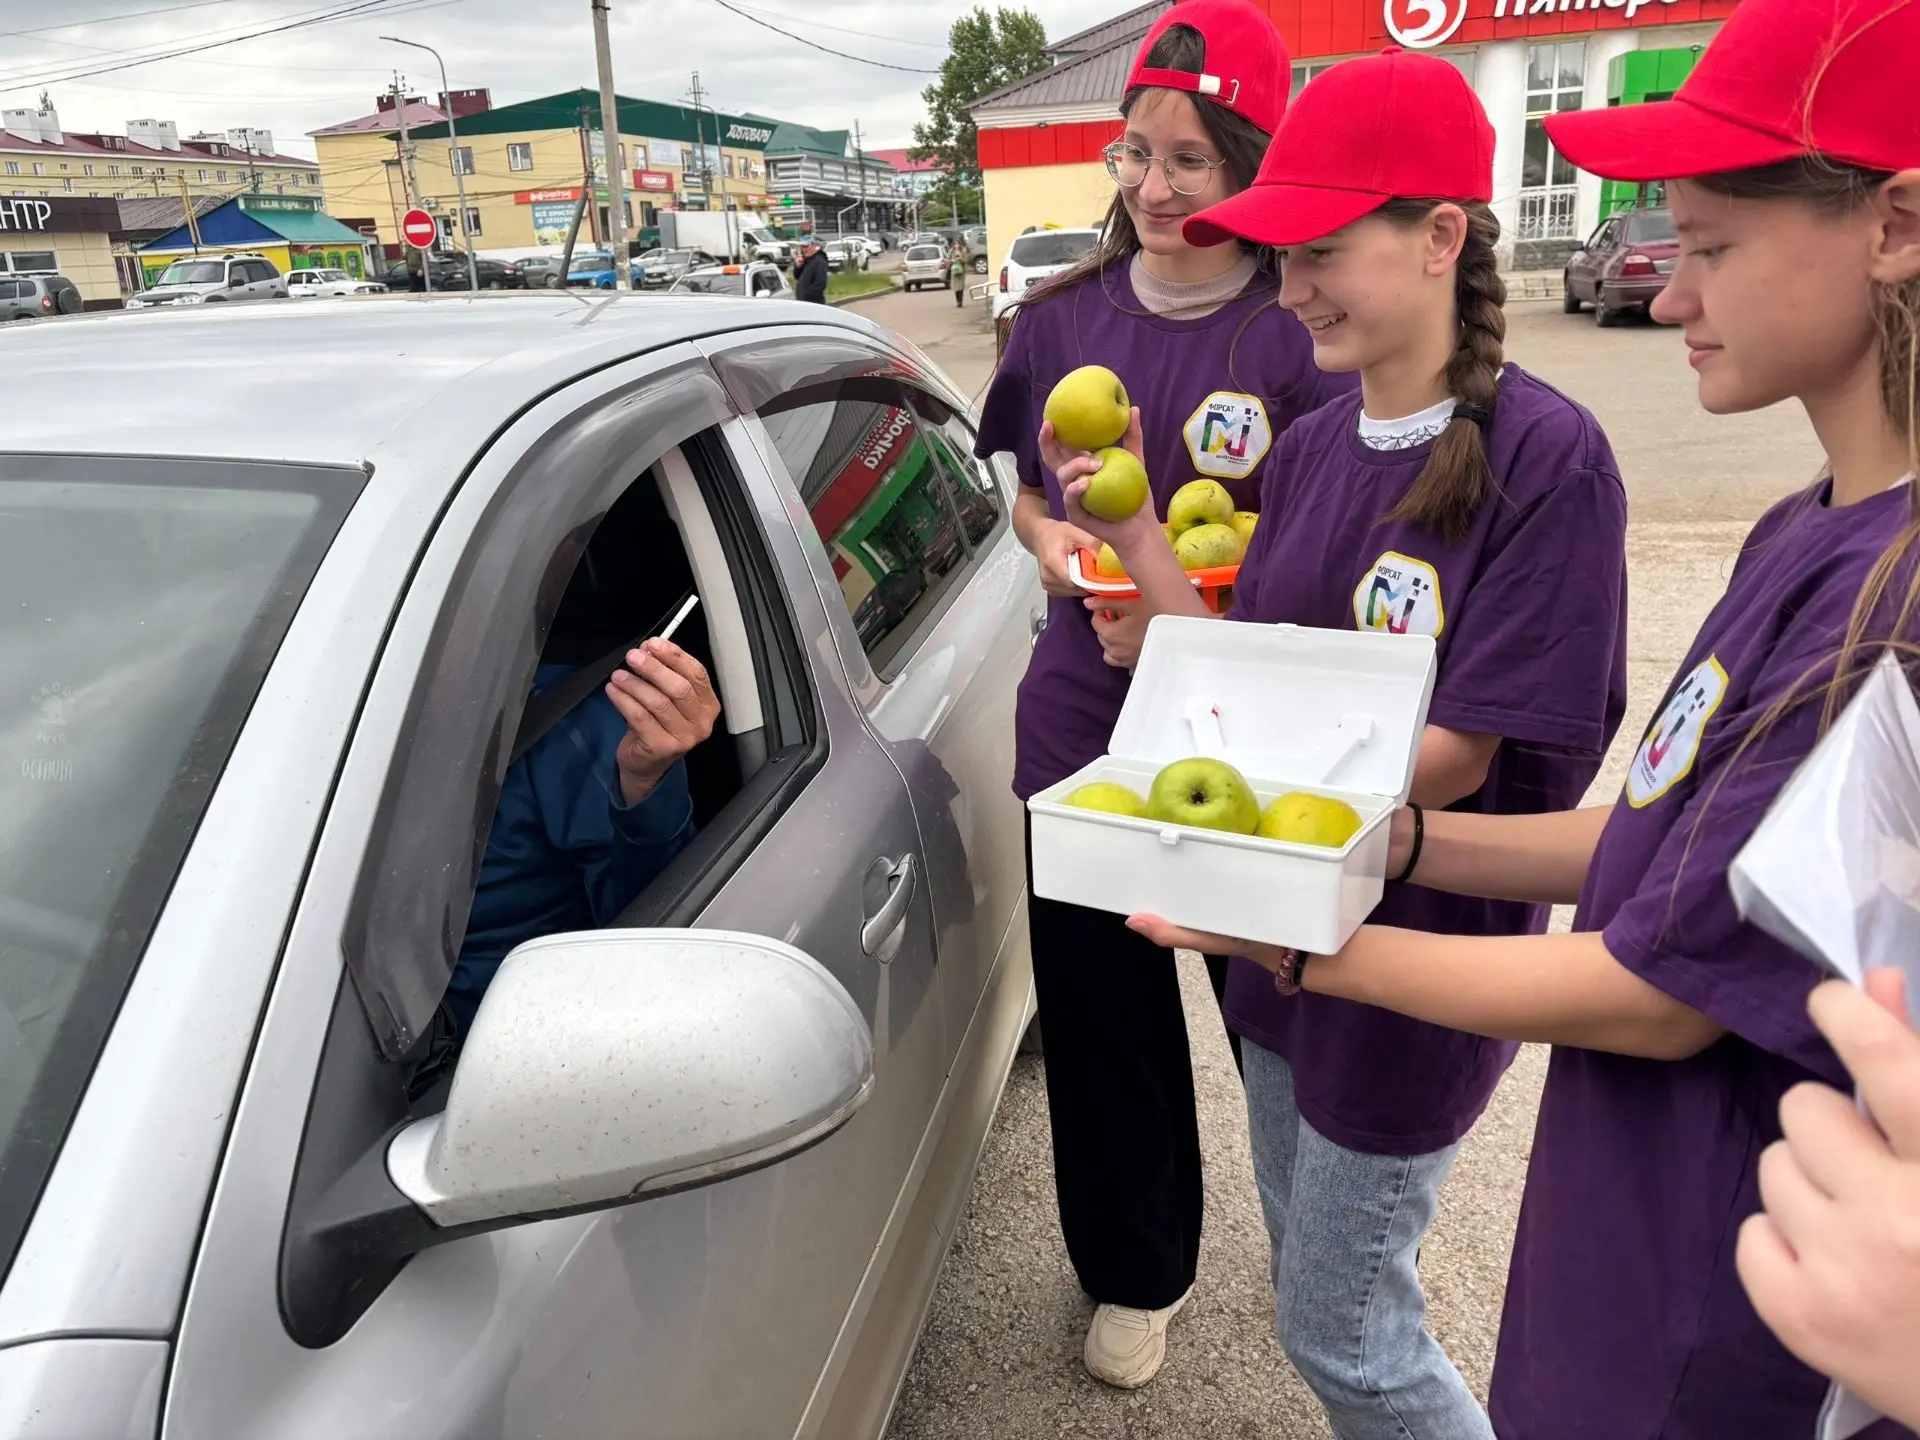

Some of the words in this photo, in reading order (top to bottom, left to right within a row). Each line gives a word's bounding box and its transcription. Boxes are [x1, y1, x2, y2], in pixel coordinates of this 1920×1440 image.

[1494, 0, 1679, 18] Пятр
[0, 199, 52, 230] НТР
[1208, 403, 1235, 414] ФОРСАТ
[1377, 565, 1403, 581] ФОРСАТ
[21, 756, 73, 784] OCTAVIA
